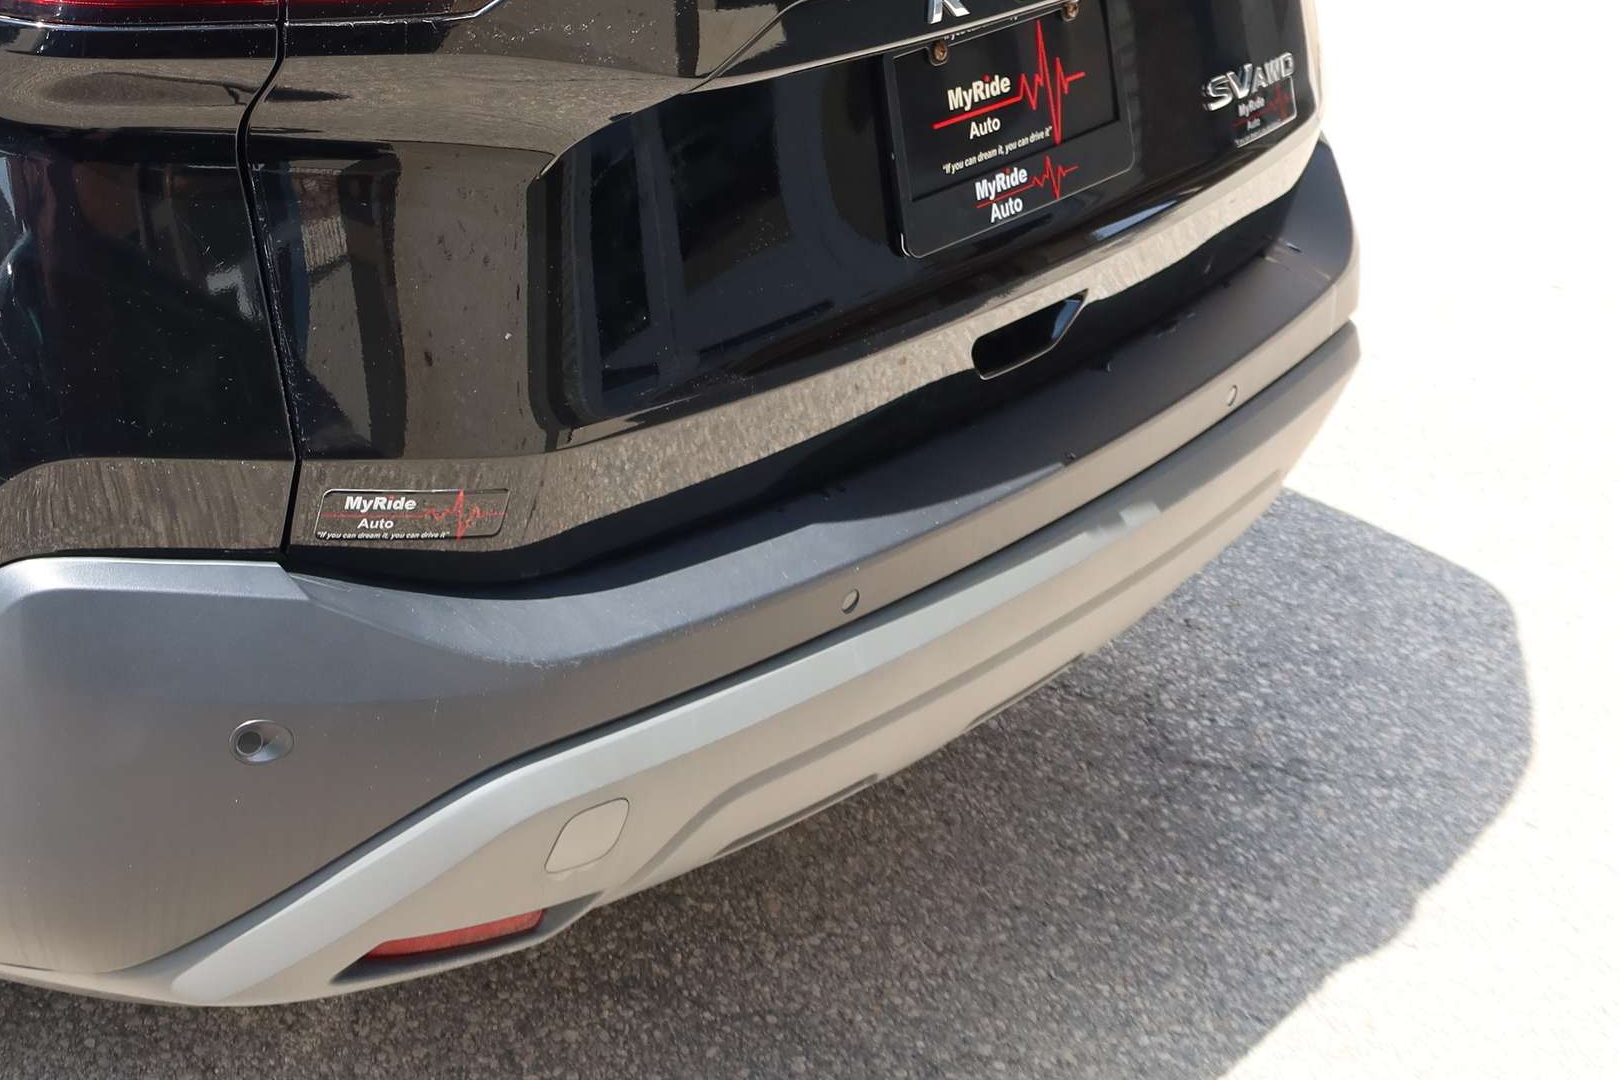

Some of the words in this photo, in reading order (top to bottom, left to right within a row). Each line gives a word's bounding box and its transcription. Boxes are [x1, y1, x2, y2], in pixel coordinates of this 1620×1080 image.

[1252, 52, 1294, 94] AWD
[947, 74, 1011, 111] MyRide
[969, 116, 1001, 140] Auto
[951, 160, 964, 174] you
[964, 156, 977, 167] can
[977, 148, 998, 162] dream
[1004, 141, 1018, 155] you
[1017, 136, 1029, 147] can
[1029, 130, 1045, 143] drive
[974, 167, 1028, 201] MyRide
[990, 196, 1023, 223] Auto
[344, 495, 417, 513] MyRide
[327, 532, 341, 540] you
[357, 531, 380, 539] dream
[390, 532, 406, 540] you
[419, 531, 437, 539] drive
[357, 519, 394, 529] Auto
